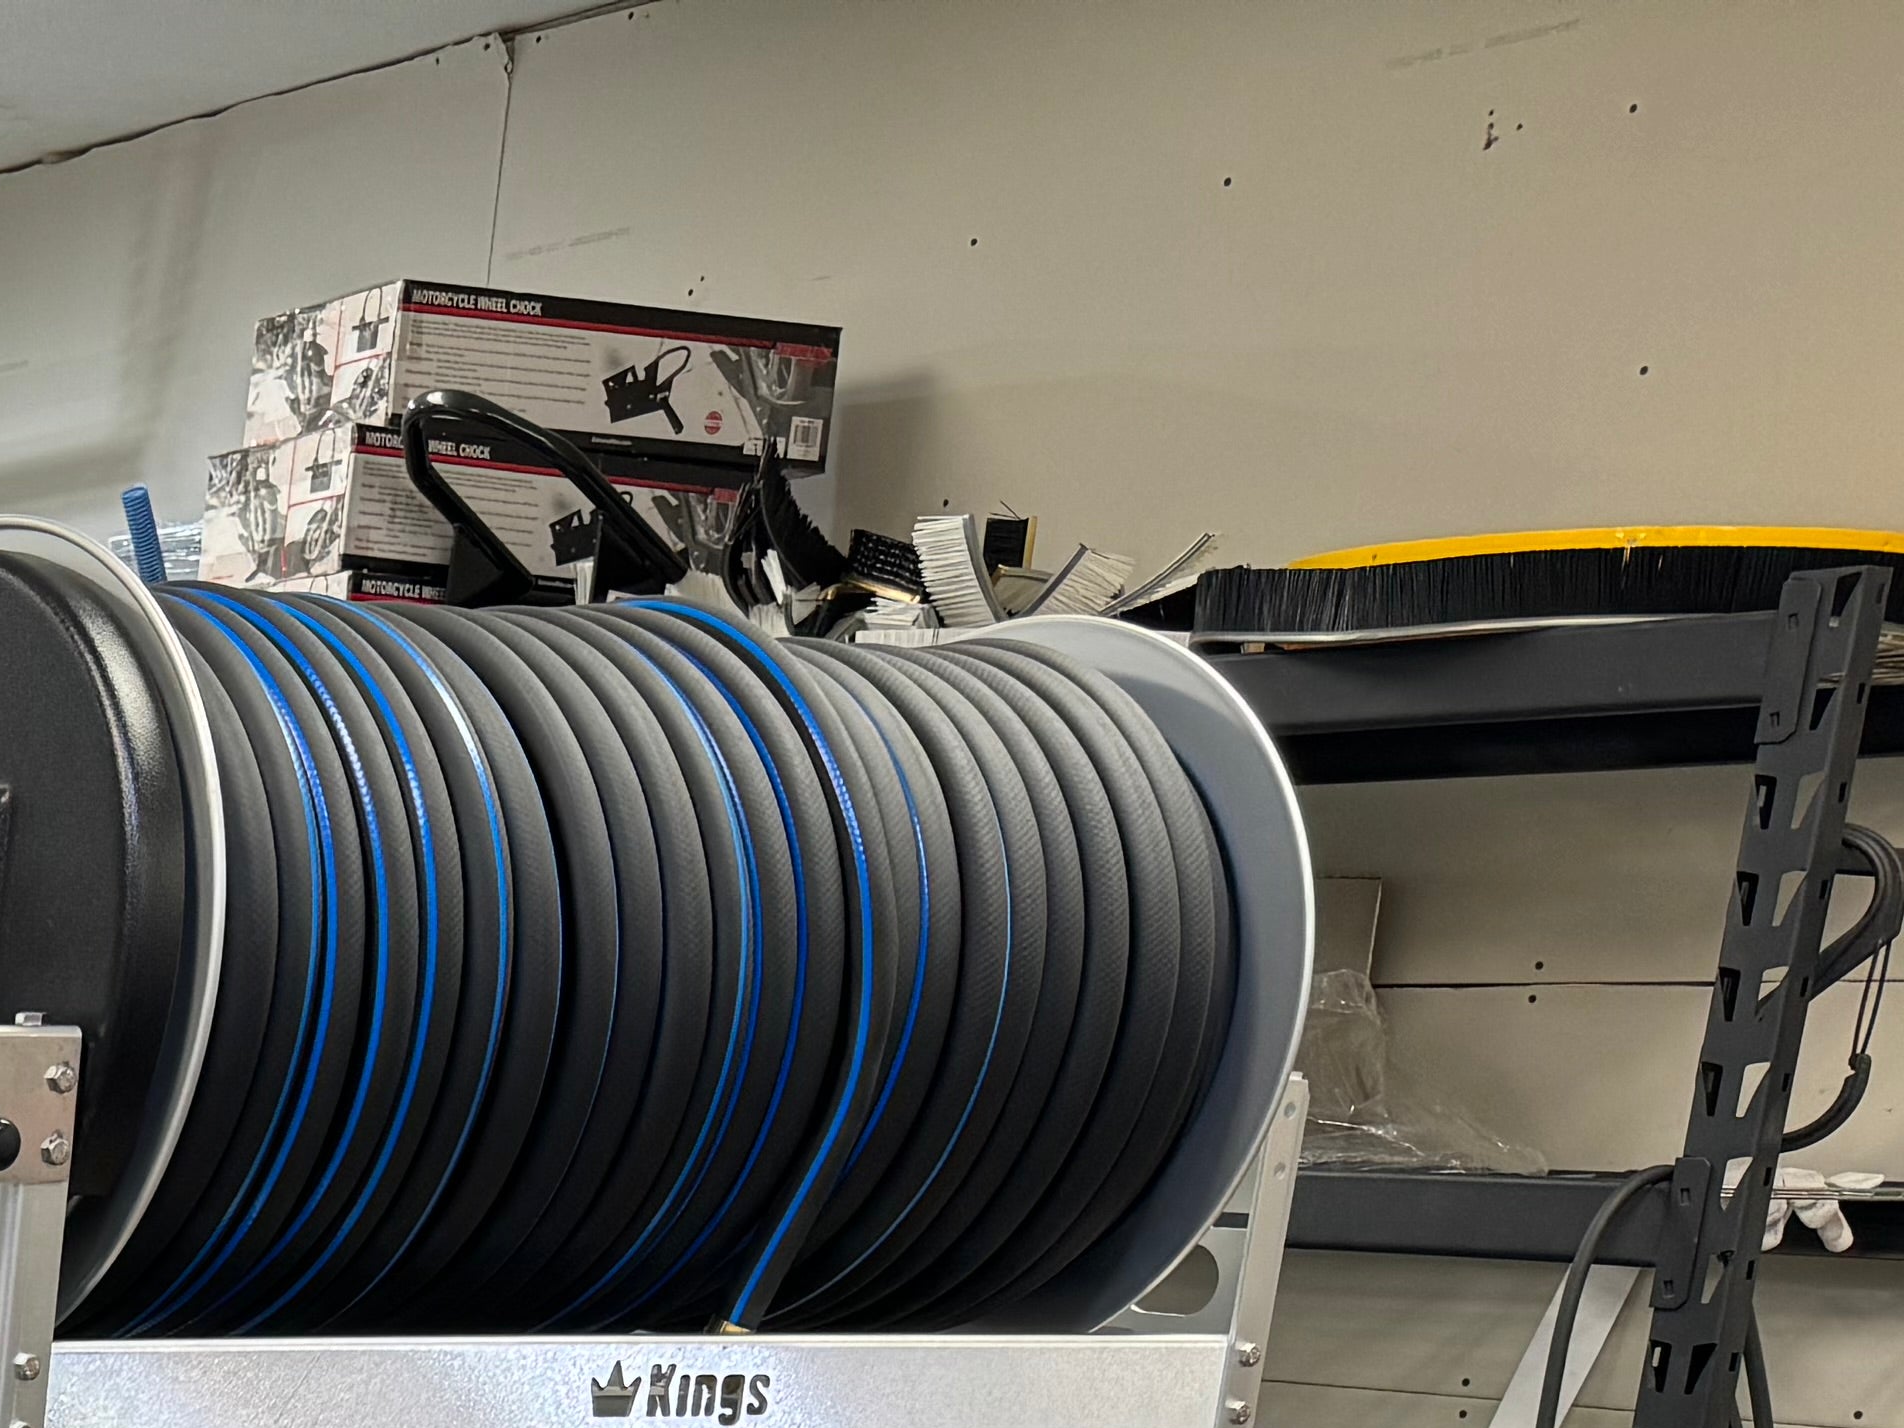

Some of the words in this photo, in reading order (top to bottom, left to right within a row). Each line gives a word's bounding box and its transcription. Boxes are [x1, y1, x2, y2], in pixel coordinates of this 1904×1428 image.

[411, 289, 476, 309] MOTORCYCLE
[477, 296, 508, 308] WHEEL
[509, 299, 542, 317] CHOCK
[428, 439, 457, 457] WHEEL
[459, 443, 491, 460] CHOCK
[361, 579, 421, 599] MOTORCYCLE
[645, 1363, 770, 1427] Kings
